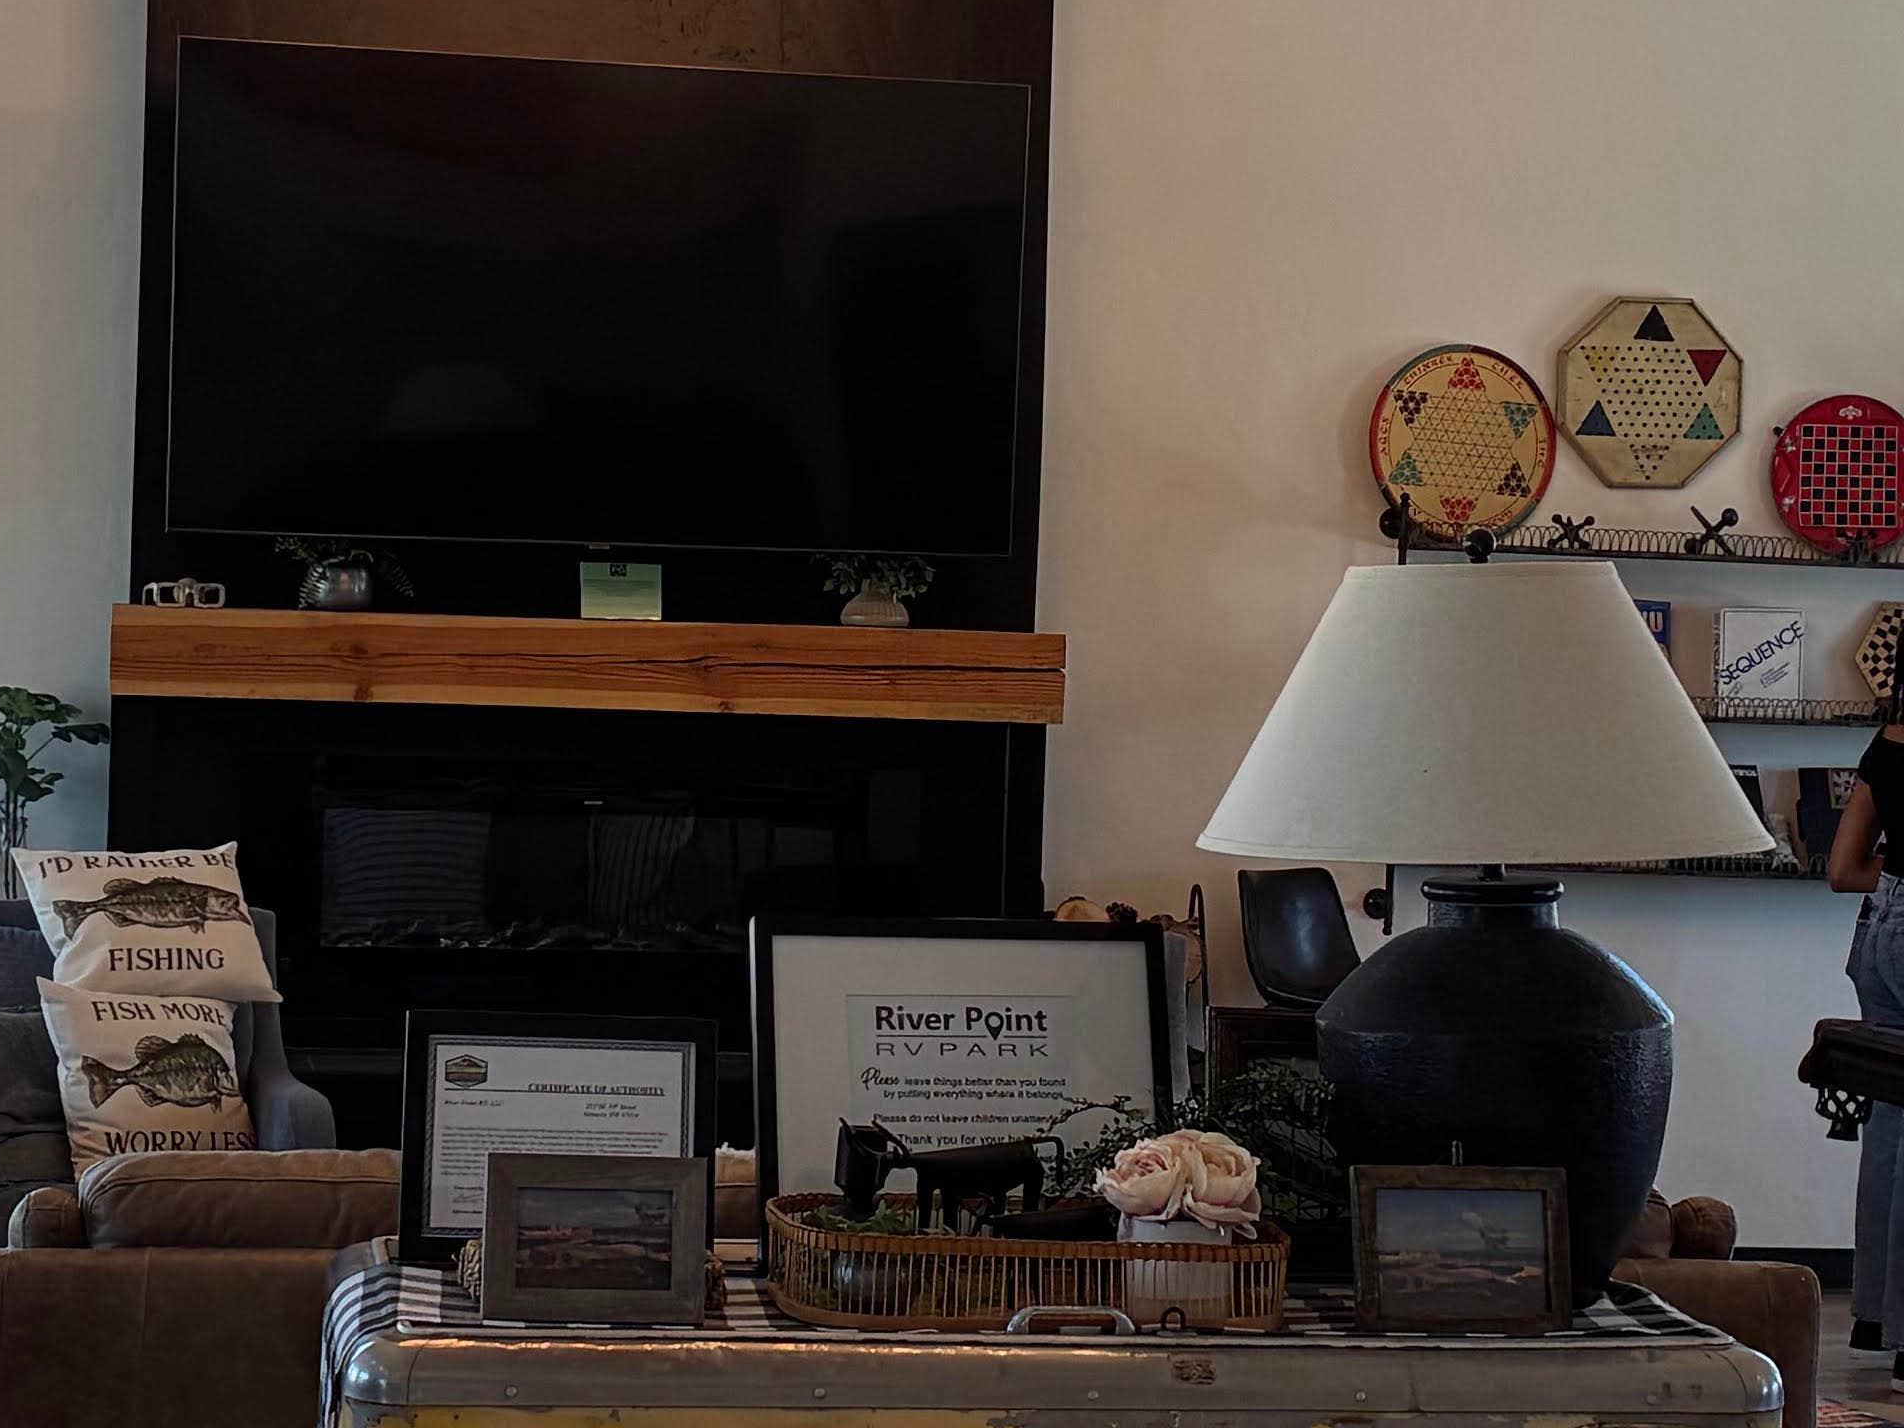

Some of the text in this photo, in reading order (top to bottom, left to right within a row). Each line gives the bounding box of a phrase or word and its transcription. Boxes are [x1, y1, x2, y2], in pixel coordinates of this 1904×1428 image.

[1720, 620, 1805, 686] SEQUENCE
[38, 855, 73, 878] I'D
[83, 855, 194, 870] RATHER
[108, 947, 225, 972] FISHING
[91, 1000, 156, 1021] FISH
[875, 1005, 1048, 1036] River Point
[876, 1042, 1049, 1057] RV PARK
[860, 1067, 900, 1091] Please
[904, 1076, 931, 1086] leave
[933, 1076, 963, 1088] things
[965, 1076, 993, 1086] better
[995, 1077, 1017, 1086] than
[1018, 1078, 1037, 1088] you
[883, 1089, 894, 1100] by
[933, 1089, 983, 1100] everything
[909, 1114, 922, 1122] do
[924, 1114, 940, 1123] not
[942, 1113, 968, 1123] leave
[105, 1130, 201, 1156] WORRY
[896, 1132, 933, 1145] Thank
[937, 1135, 957, 1147] you
[960, 1133, 976, 1145] for
